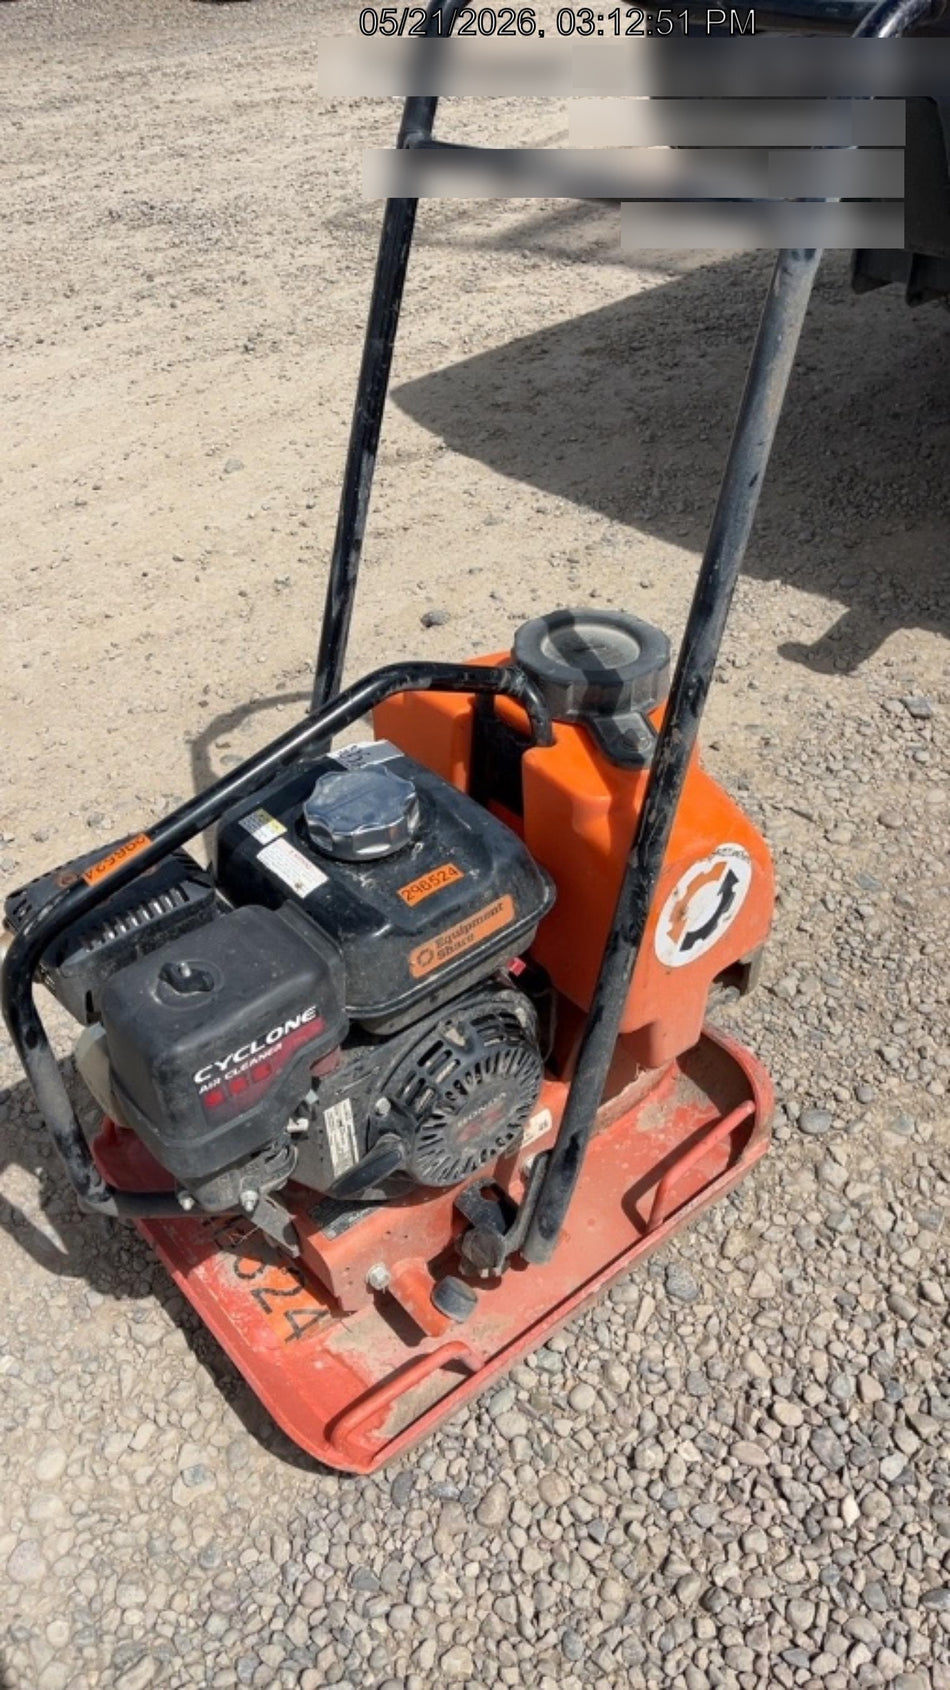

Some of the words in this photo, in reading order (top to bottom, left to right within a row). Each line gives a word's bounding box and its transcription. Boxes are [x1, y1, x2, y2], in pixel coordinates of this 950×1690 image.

[435, 902, 504, 949] Equipment
[436, 932, 475, 961] Share
[193, 1004, 317, 1084] CYCLONE
[224, 1042, 283, 1081] CLEANER
[199, 1077, 222, 1095] AIR
